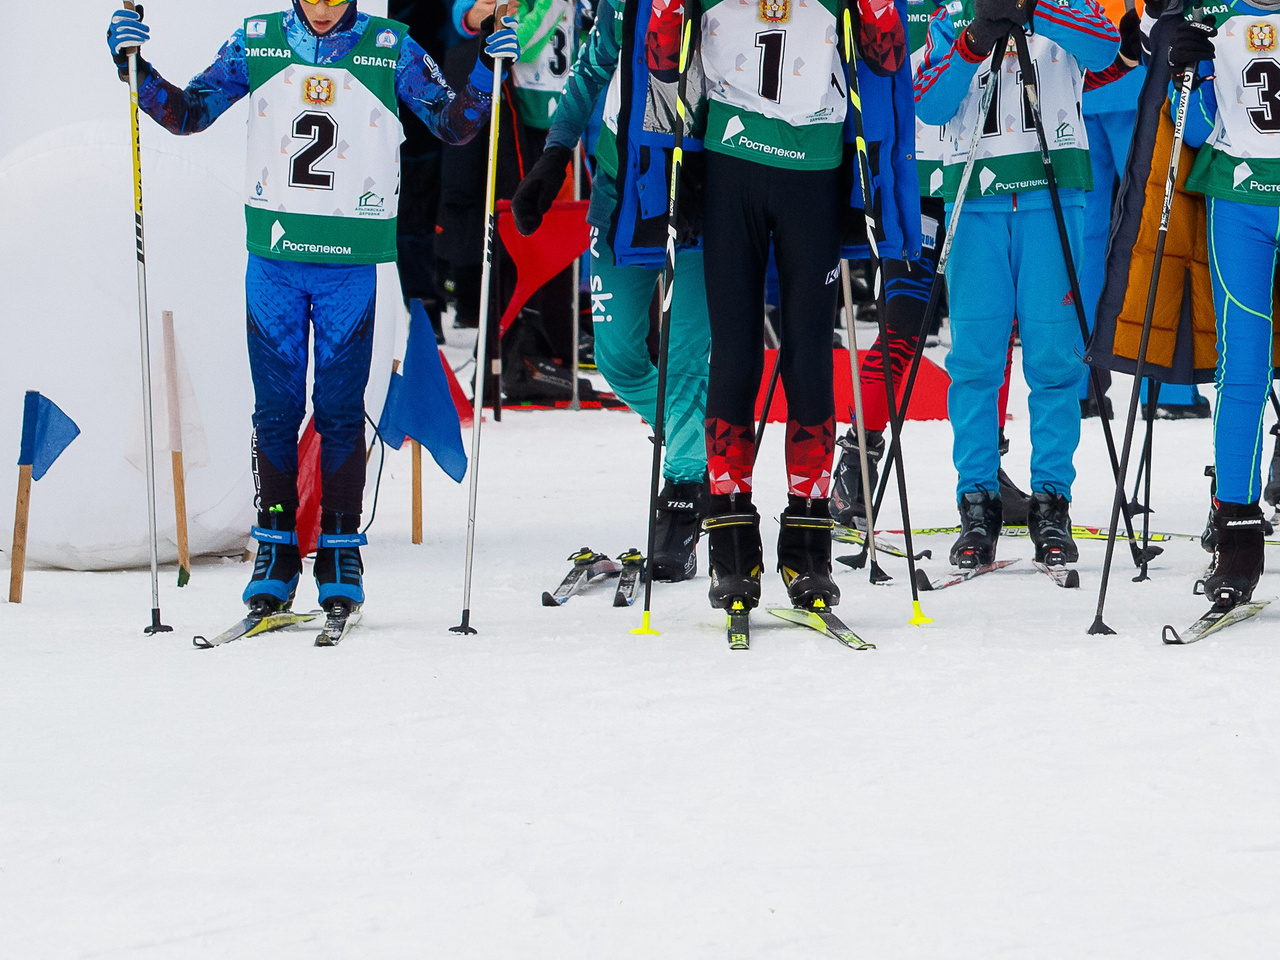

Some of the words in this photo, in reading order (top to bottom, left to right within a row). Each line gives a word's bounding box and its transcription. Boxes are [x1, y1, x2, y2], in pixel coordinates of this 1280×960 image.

[754, 29, 787, 105] 1
[1175, 89, 1189, 136] NORDWAY
[288, 110, 339, 191] 2
[738, 135, 806, 160] Ростелеком
[995, 178, 1058, 192] Ростелеко
[282, 240, 352, 255] Ростелеком
[590, 275, 613, 322] ski
[667, 500, 694, 509] TISA
